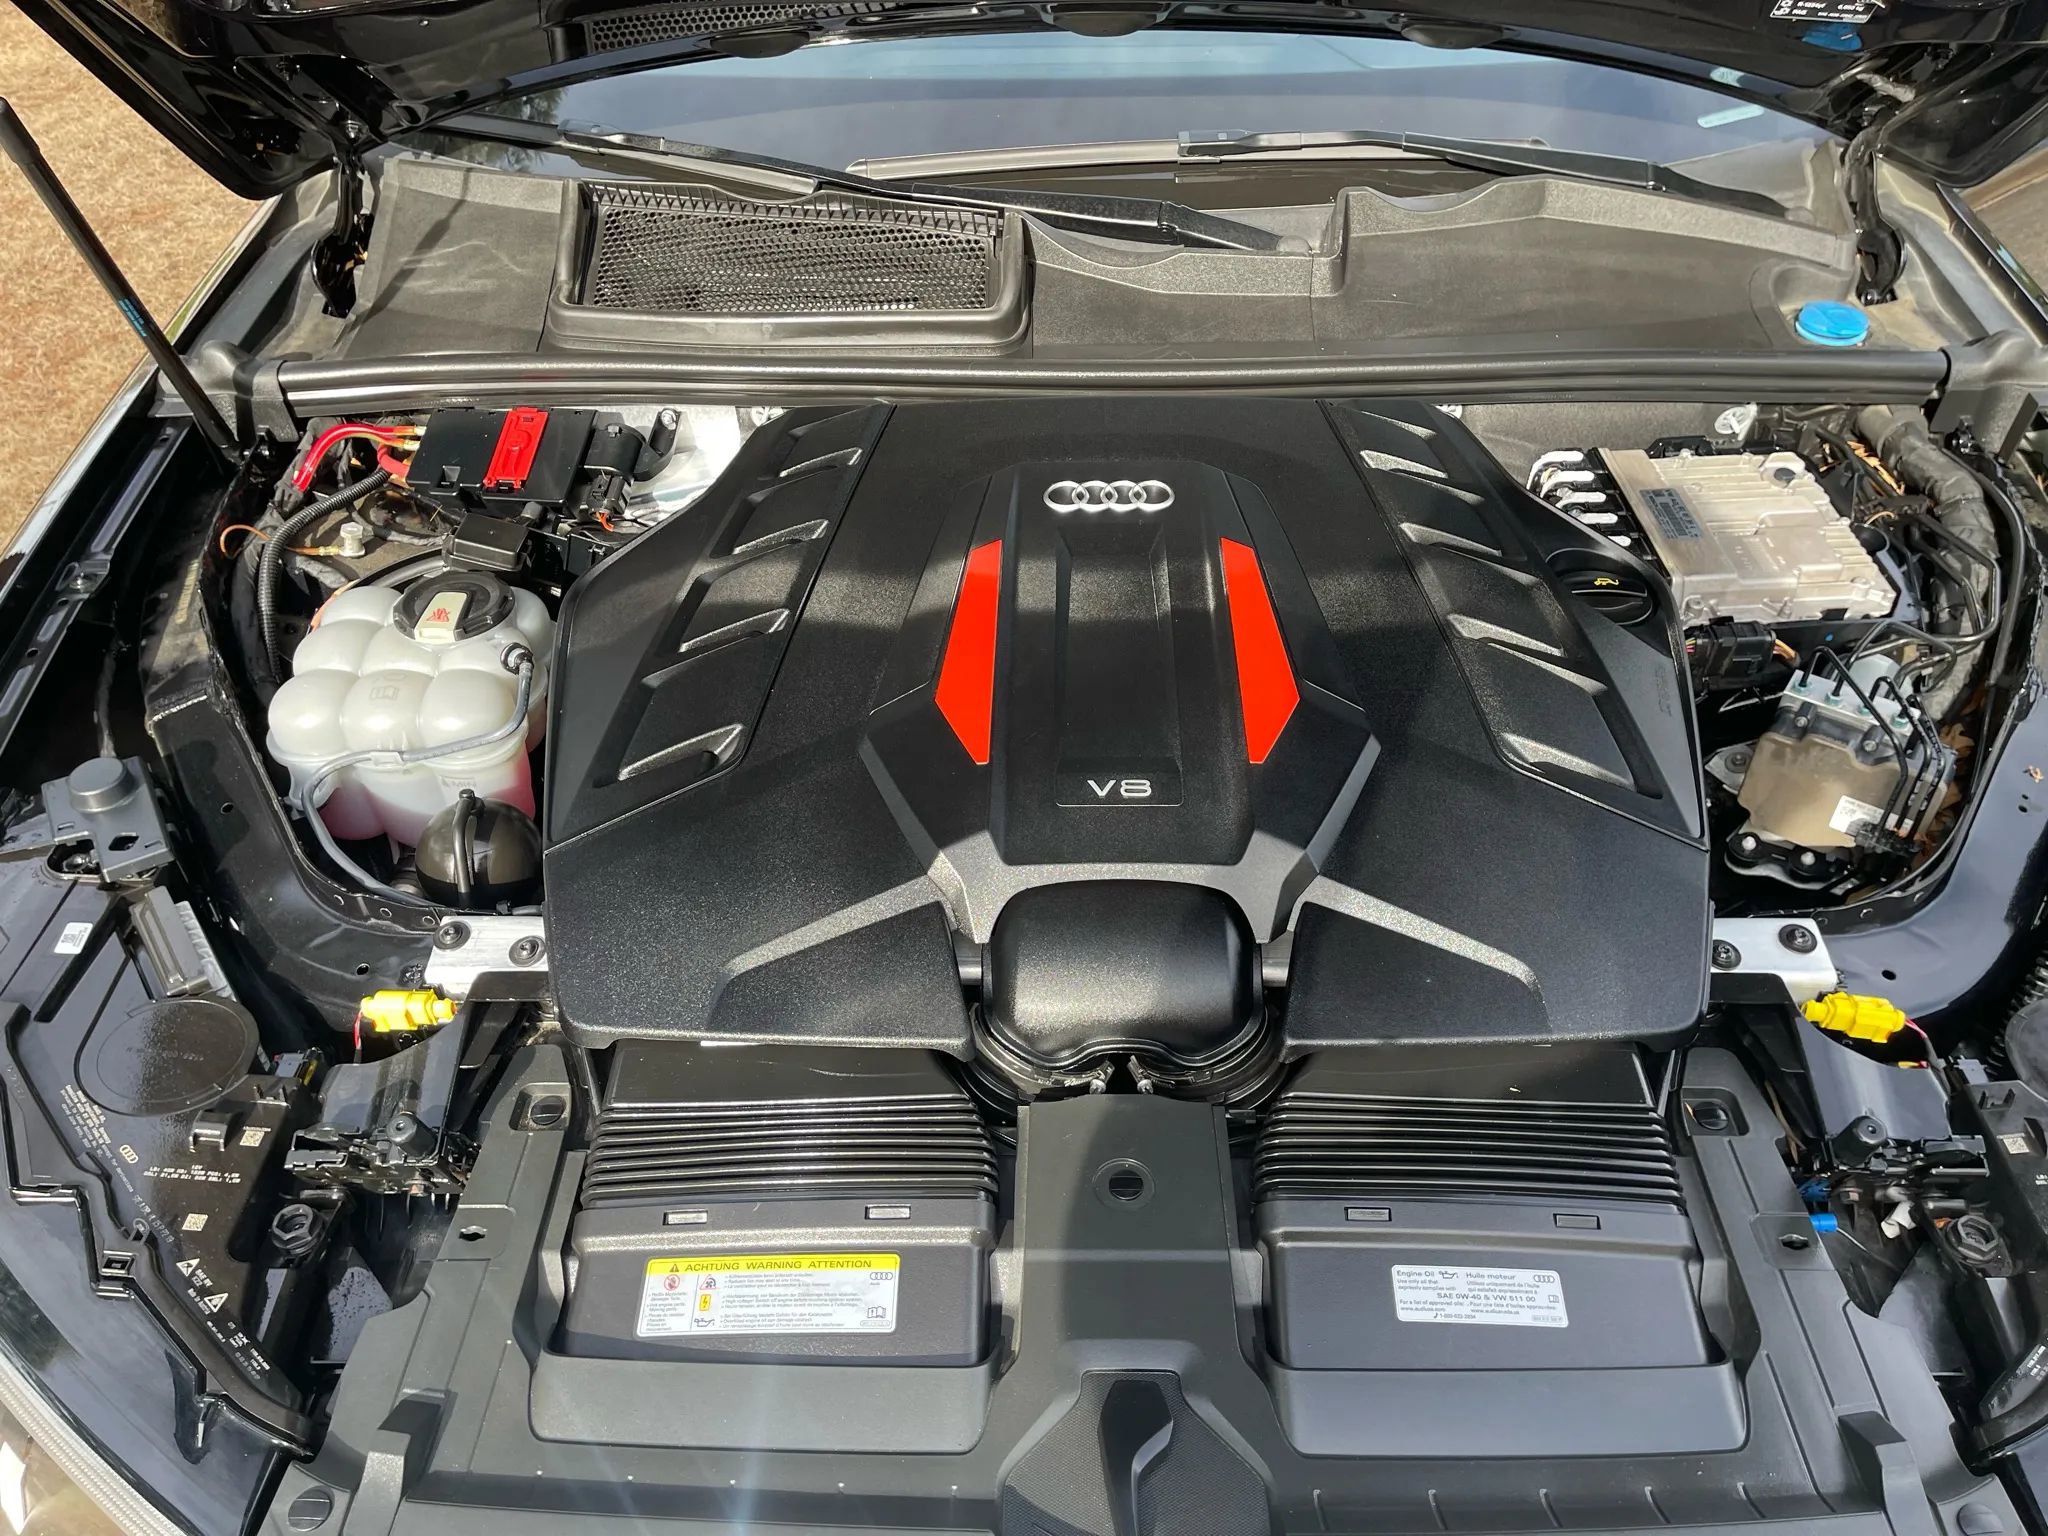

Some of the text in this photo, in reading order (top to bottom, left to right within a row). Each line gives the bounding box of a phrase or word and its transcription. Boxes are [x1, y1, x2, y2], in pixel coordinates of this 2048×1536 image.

[1087, 779, 1152, 797] V8
[685, 1260, 872, 1271] ACHTUNG WARNING ATTENTION
